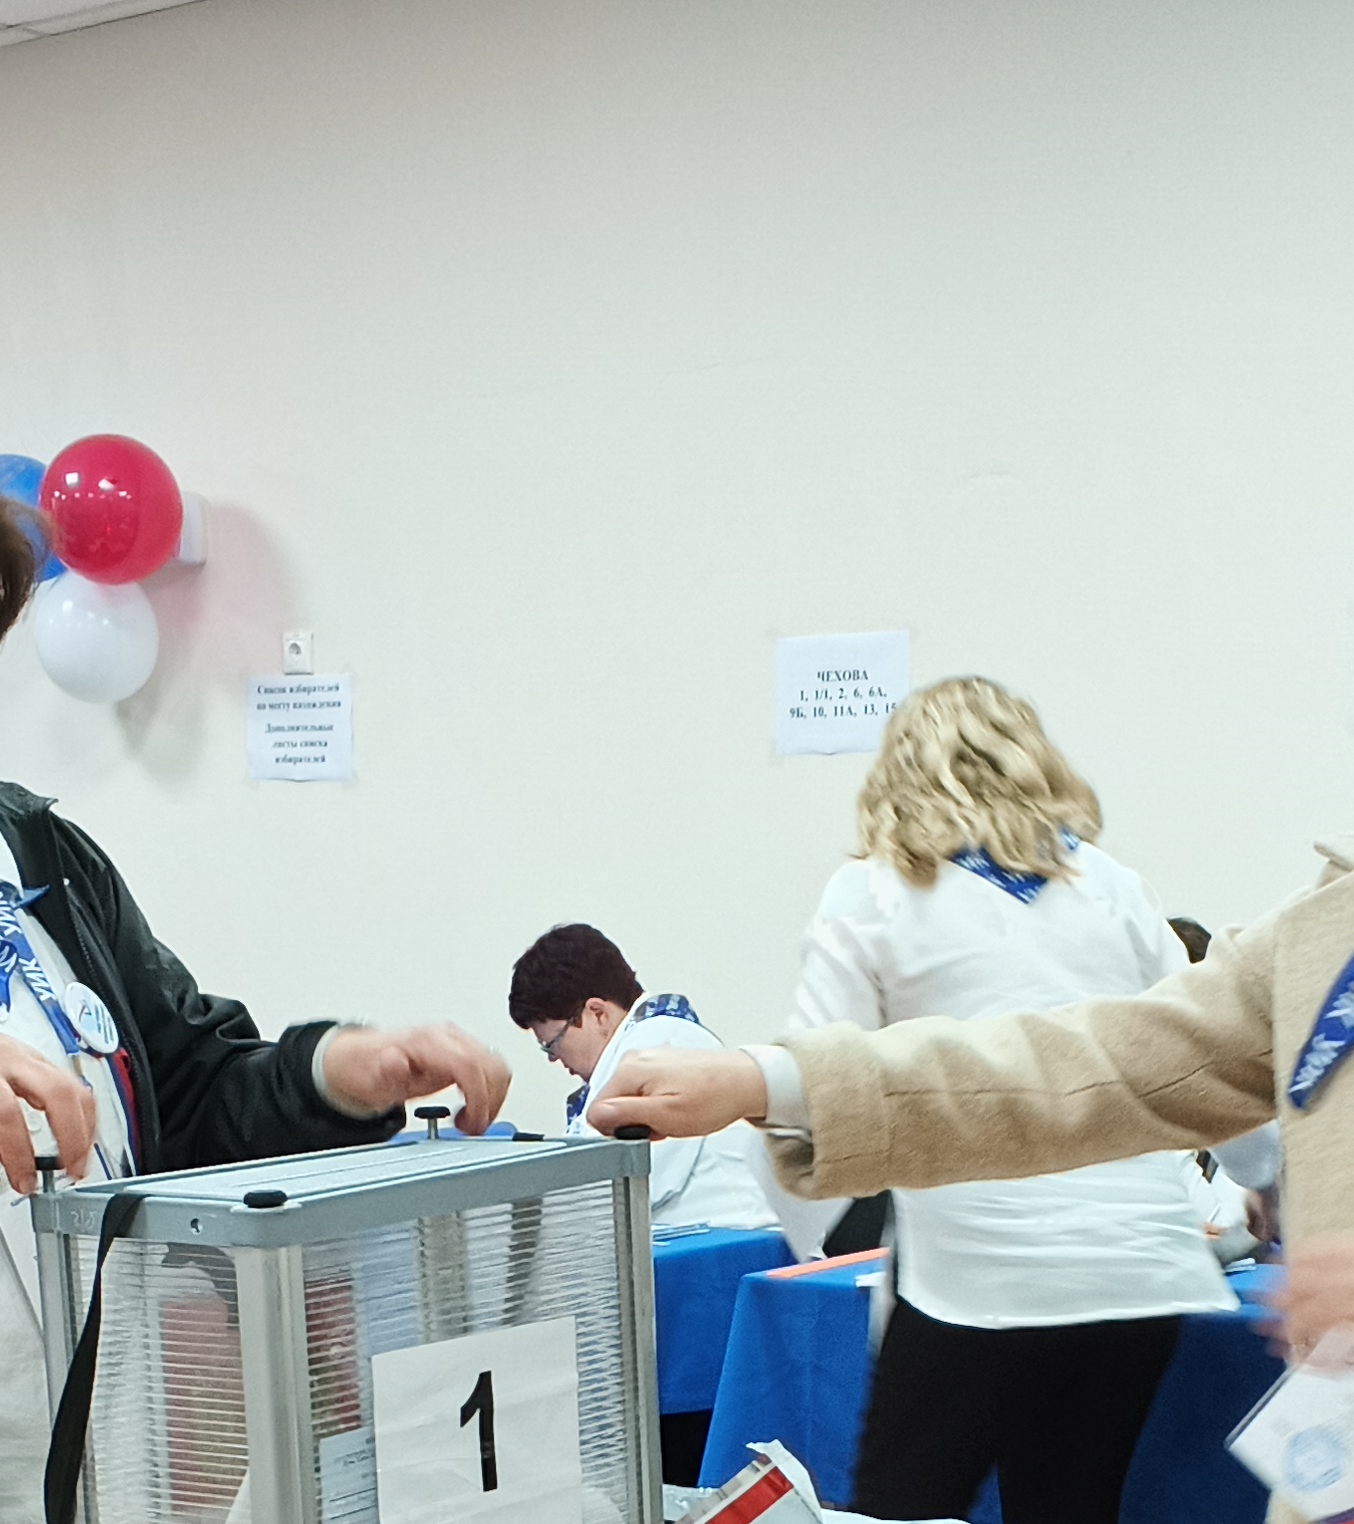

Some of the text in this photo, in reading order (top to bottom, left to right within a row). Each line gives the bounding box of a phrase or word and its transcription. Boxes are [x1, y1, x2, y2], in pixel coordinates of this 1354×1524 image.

[817, 669, 869, 682] ЧЕХОВА
[257, 685, 287, 694] Список
[800, 690, 809, 702] 1,
[814, 689, 833, 700] 1/1,
[853, 686, 863, 699] 6,
[813, 706, 827, 719] 10,
[864, 703, 878, 716] 13,
[299, 739, 328, 748] списка
[19, 957, 58, 1001] УИК
[459, 1369, 500, 1493] 1
